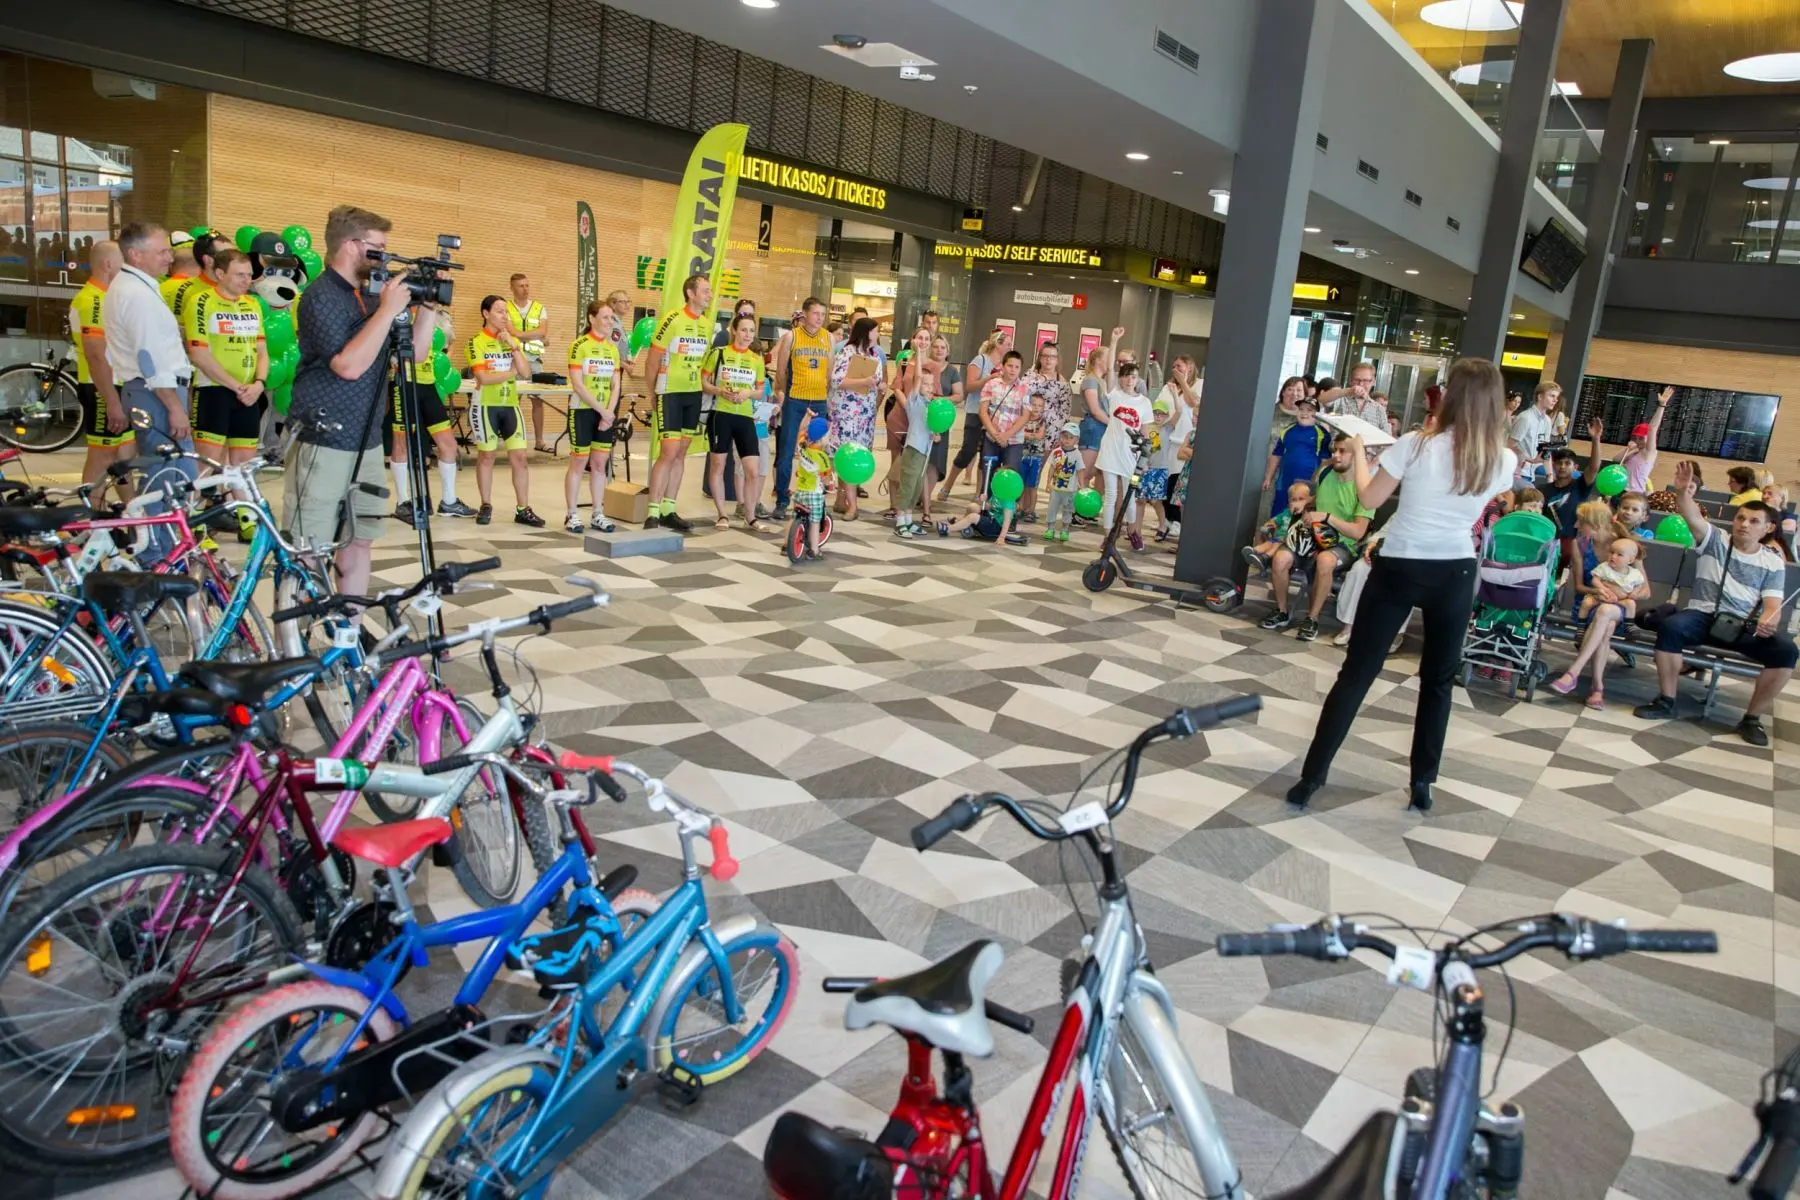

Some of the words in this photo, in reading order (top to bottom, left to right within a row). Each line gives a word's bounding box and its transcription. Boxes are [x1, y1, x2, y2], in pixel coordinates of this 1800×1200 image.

[781, 165, 827, 196] KASOS
[836, 179, 886, 210] TICKETS
[690, 157, 726, 276] RATAI
[760, 221, 770, 246] 2
[1010, 246, 1037, 261] SELF
[1039, 247, 1087, 264] SERVICE
[96, 391, 106, 432] VIRATAI
